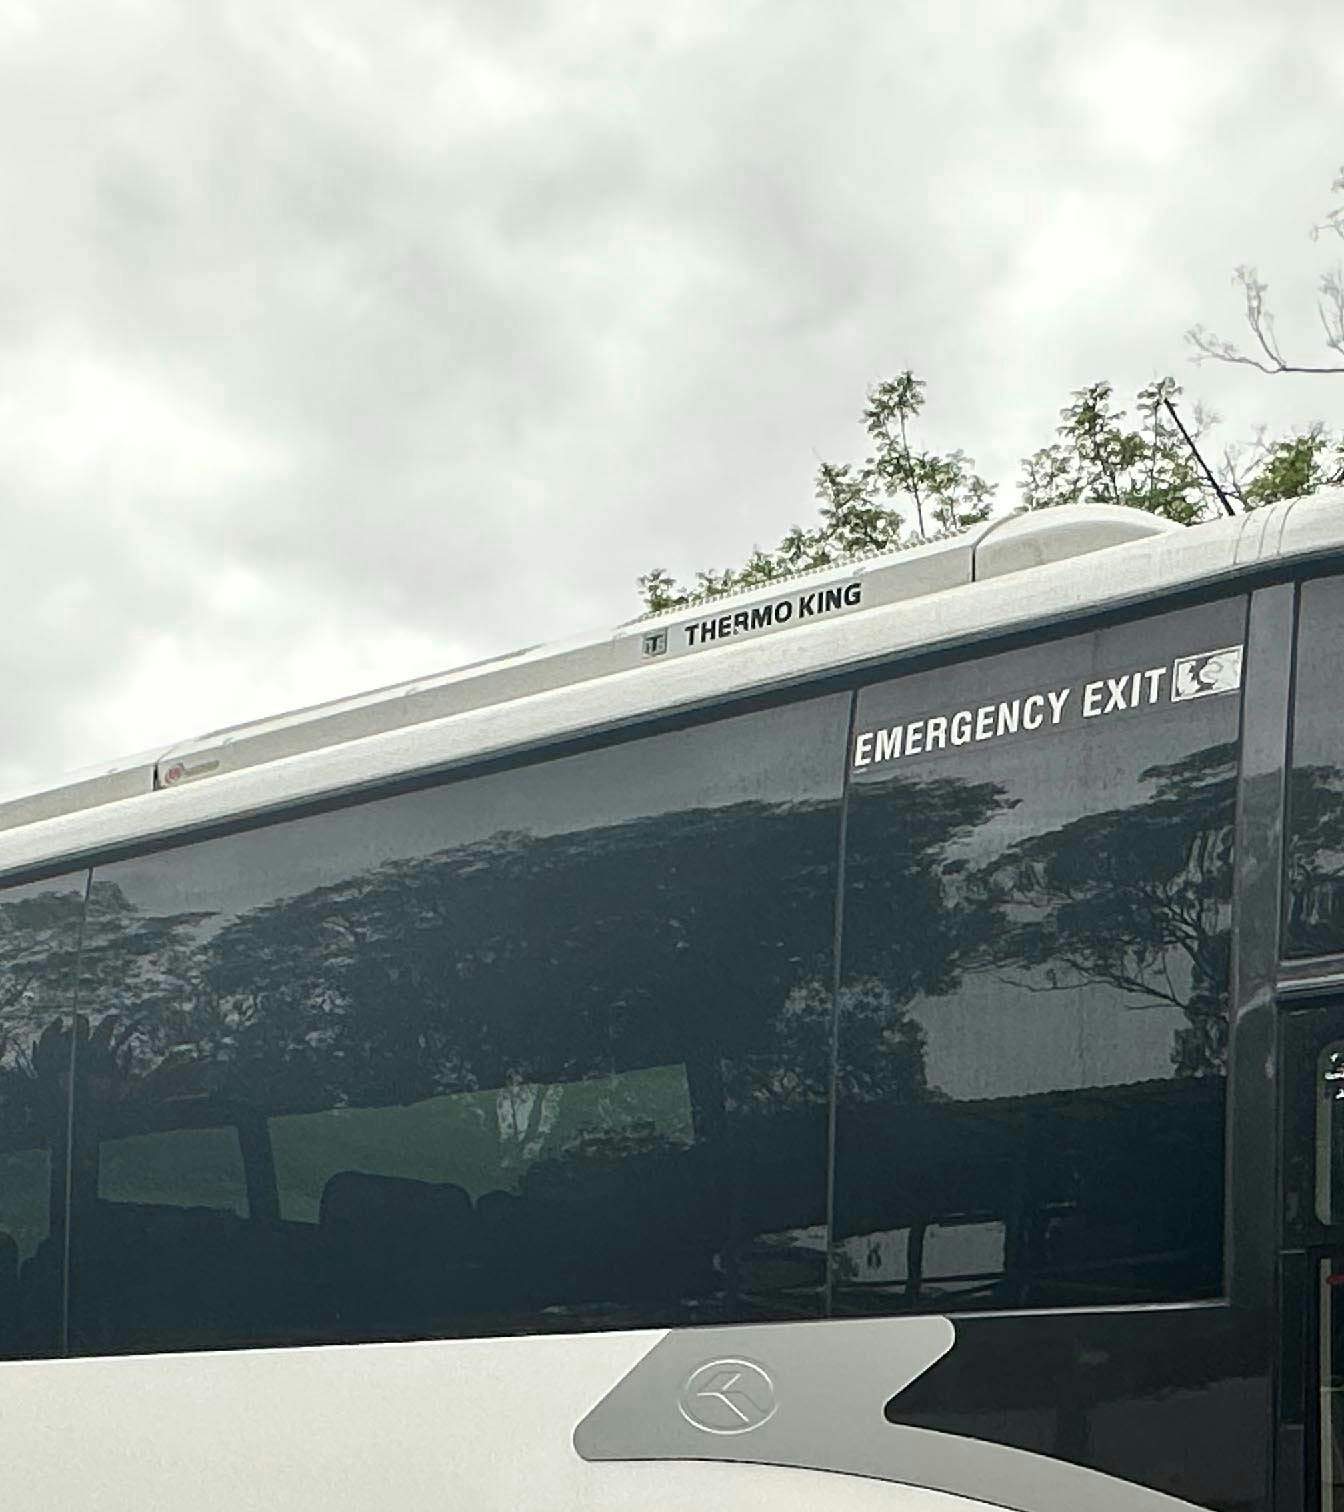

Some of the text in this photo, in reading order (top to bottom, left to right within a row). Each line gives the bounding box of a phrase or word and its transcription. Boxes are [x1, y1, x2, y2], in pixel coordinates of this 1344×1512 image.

[684, 600, 793, 646] THERMO
[798, 582, 862, 619] KING
[854, 666, 1168, 768] EMERGENCY EXIT
